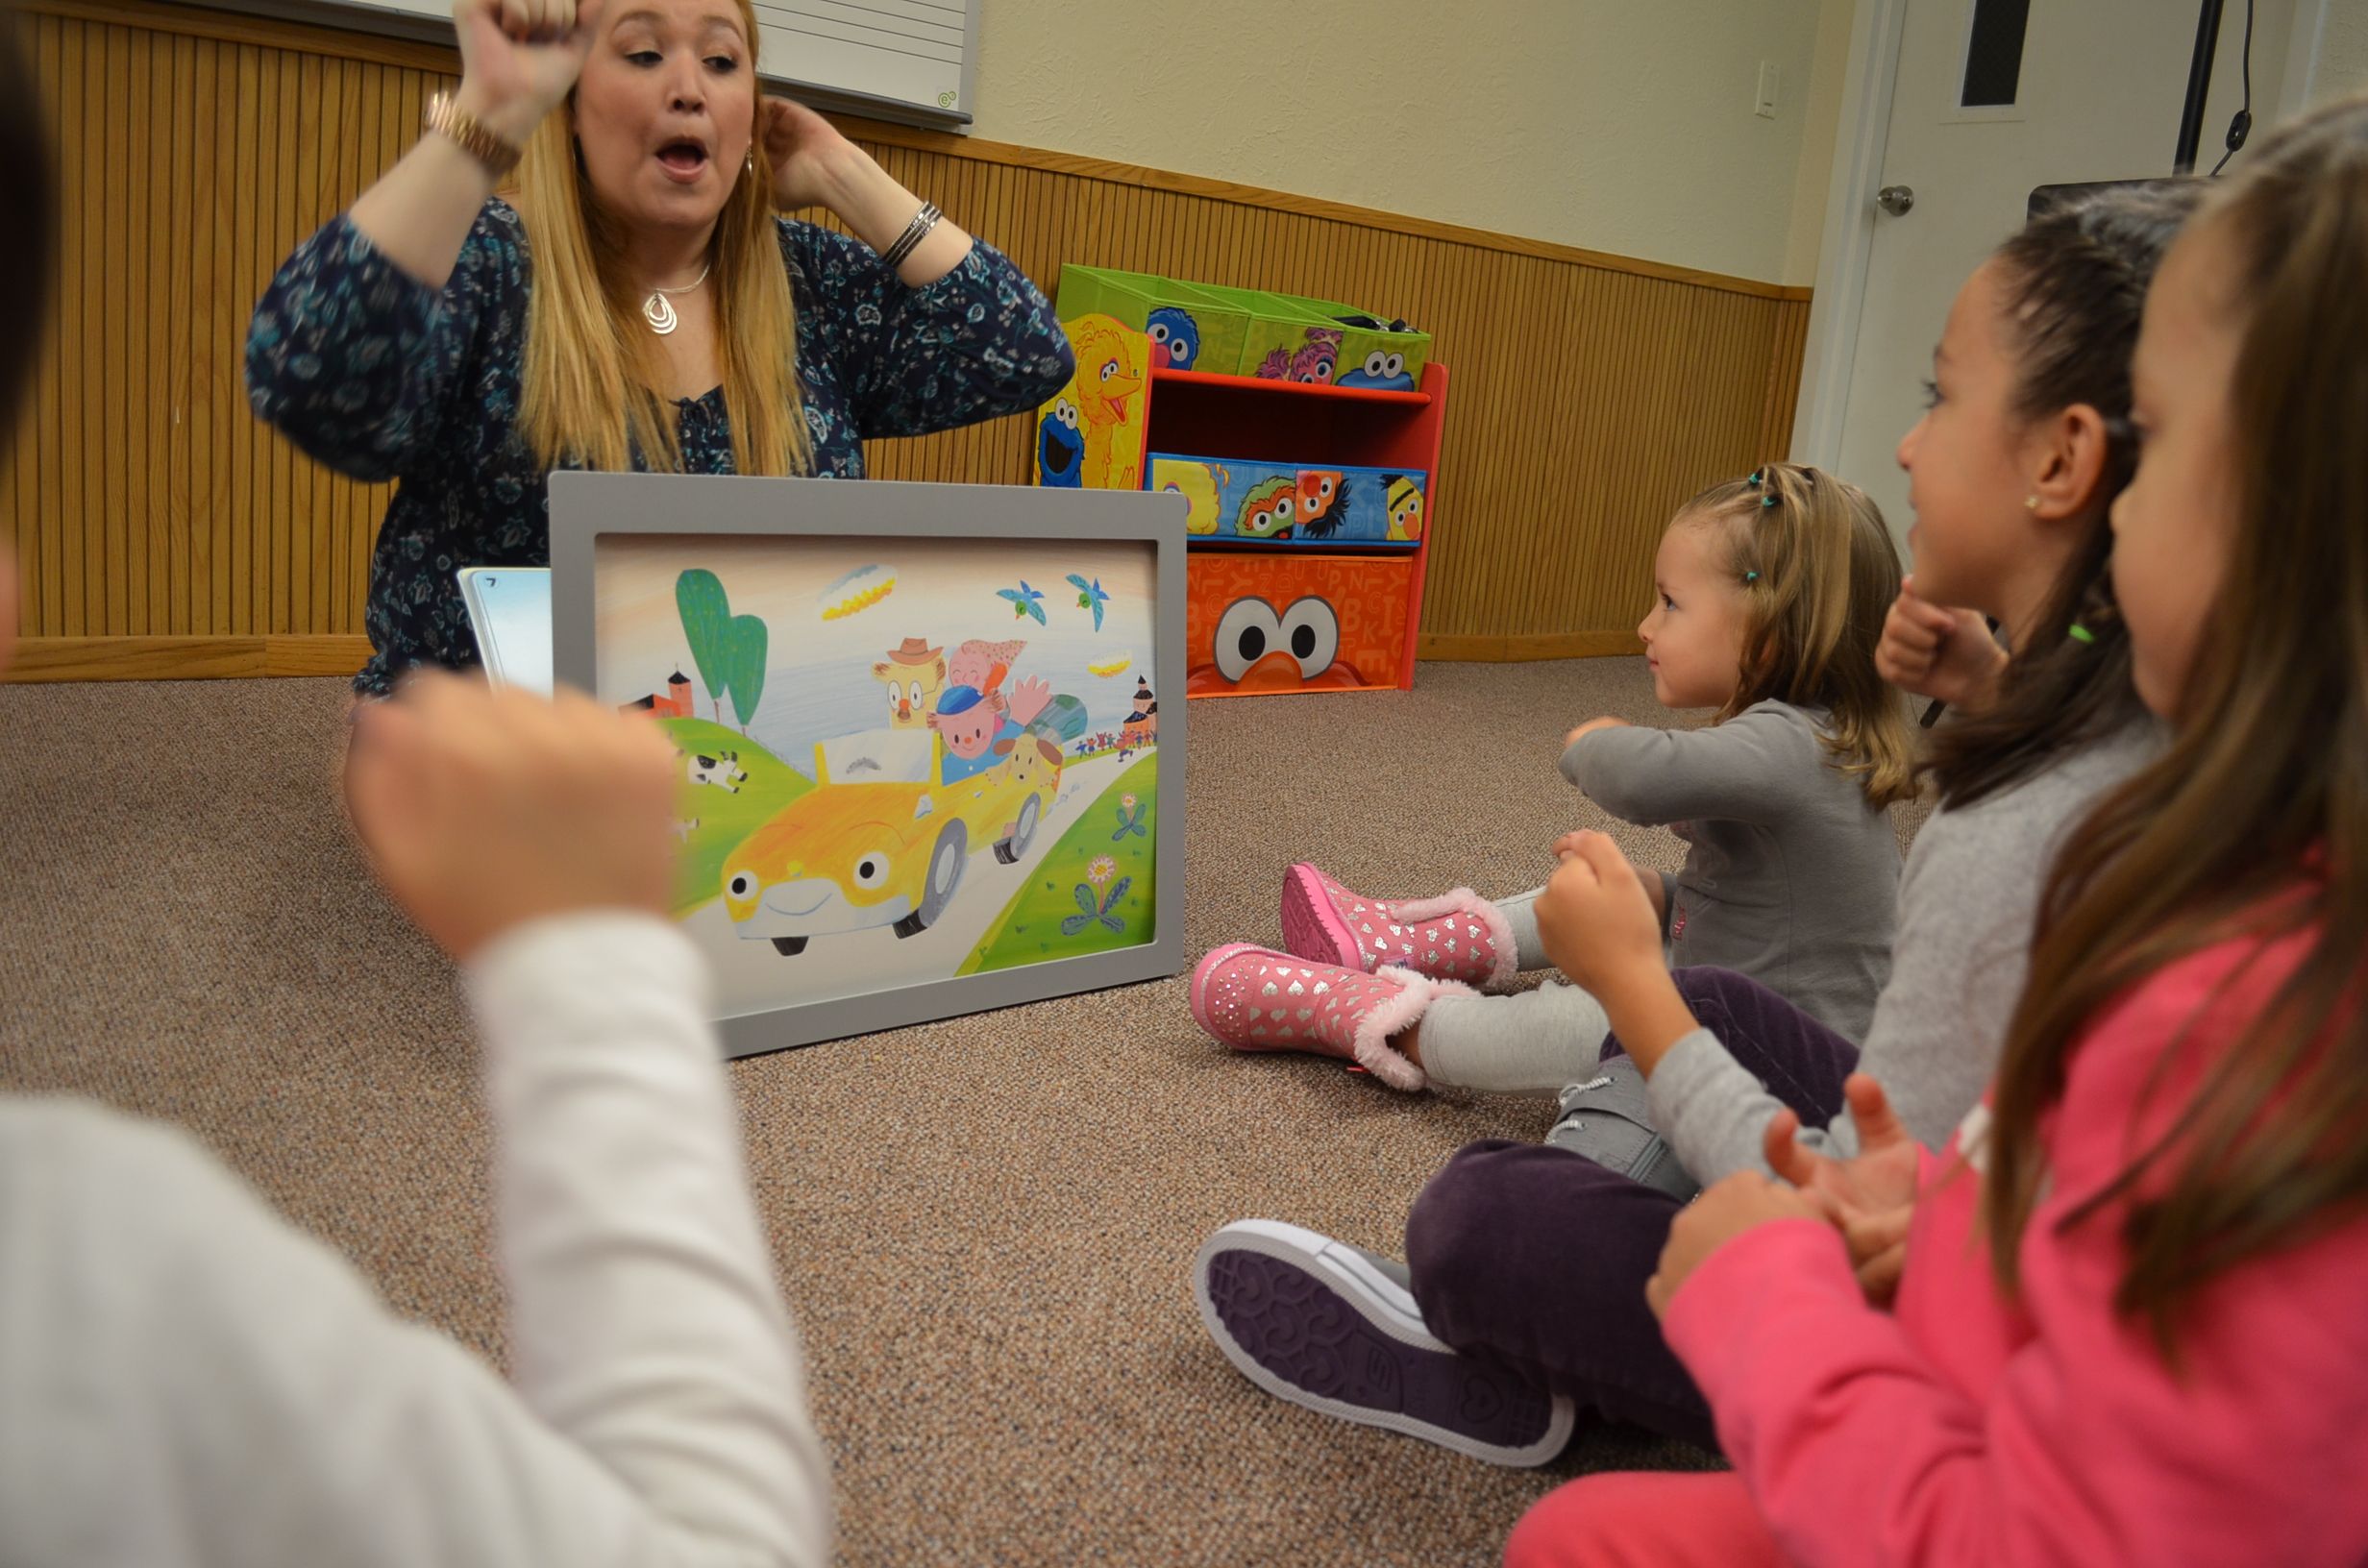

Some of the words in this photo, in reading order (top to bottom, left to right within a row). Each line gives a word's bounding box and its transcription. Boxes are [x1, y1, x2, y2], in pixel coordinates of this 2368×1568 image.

[1327, 570, 1342, 591] P
[1348, 569, 1365, 591] N
[1342, 598, 1362, 632] B
